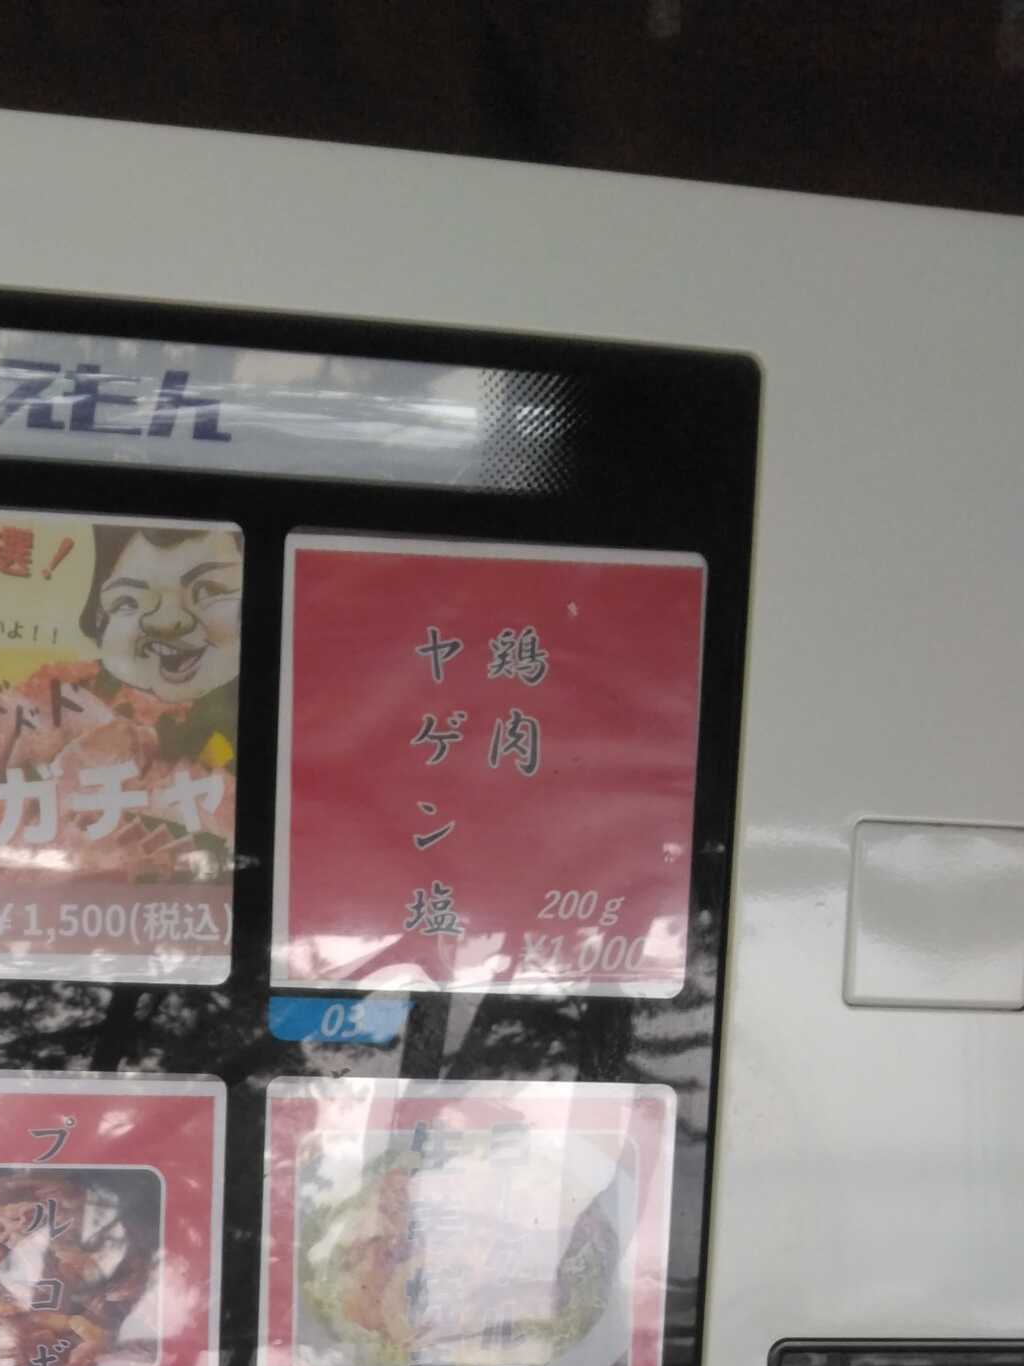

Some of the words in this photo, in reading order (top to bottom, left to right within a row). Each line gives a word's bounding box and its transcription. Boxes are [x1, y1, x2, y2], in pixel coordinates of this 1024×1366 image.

[488, 626, 549, 776] 鶏肉
[405, 626, 467, 937] ヤゲン塩
[519, 931, 649, 975] ¥1000
